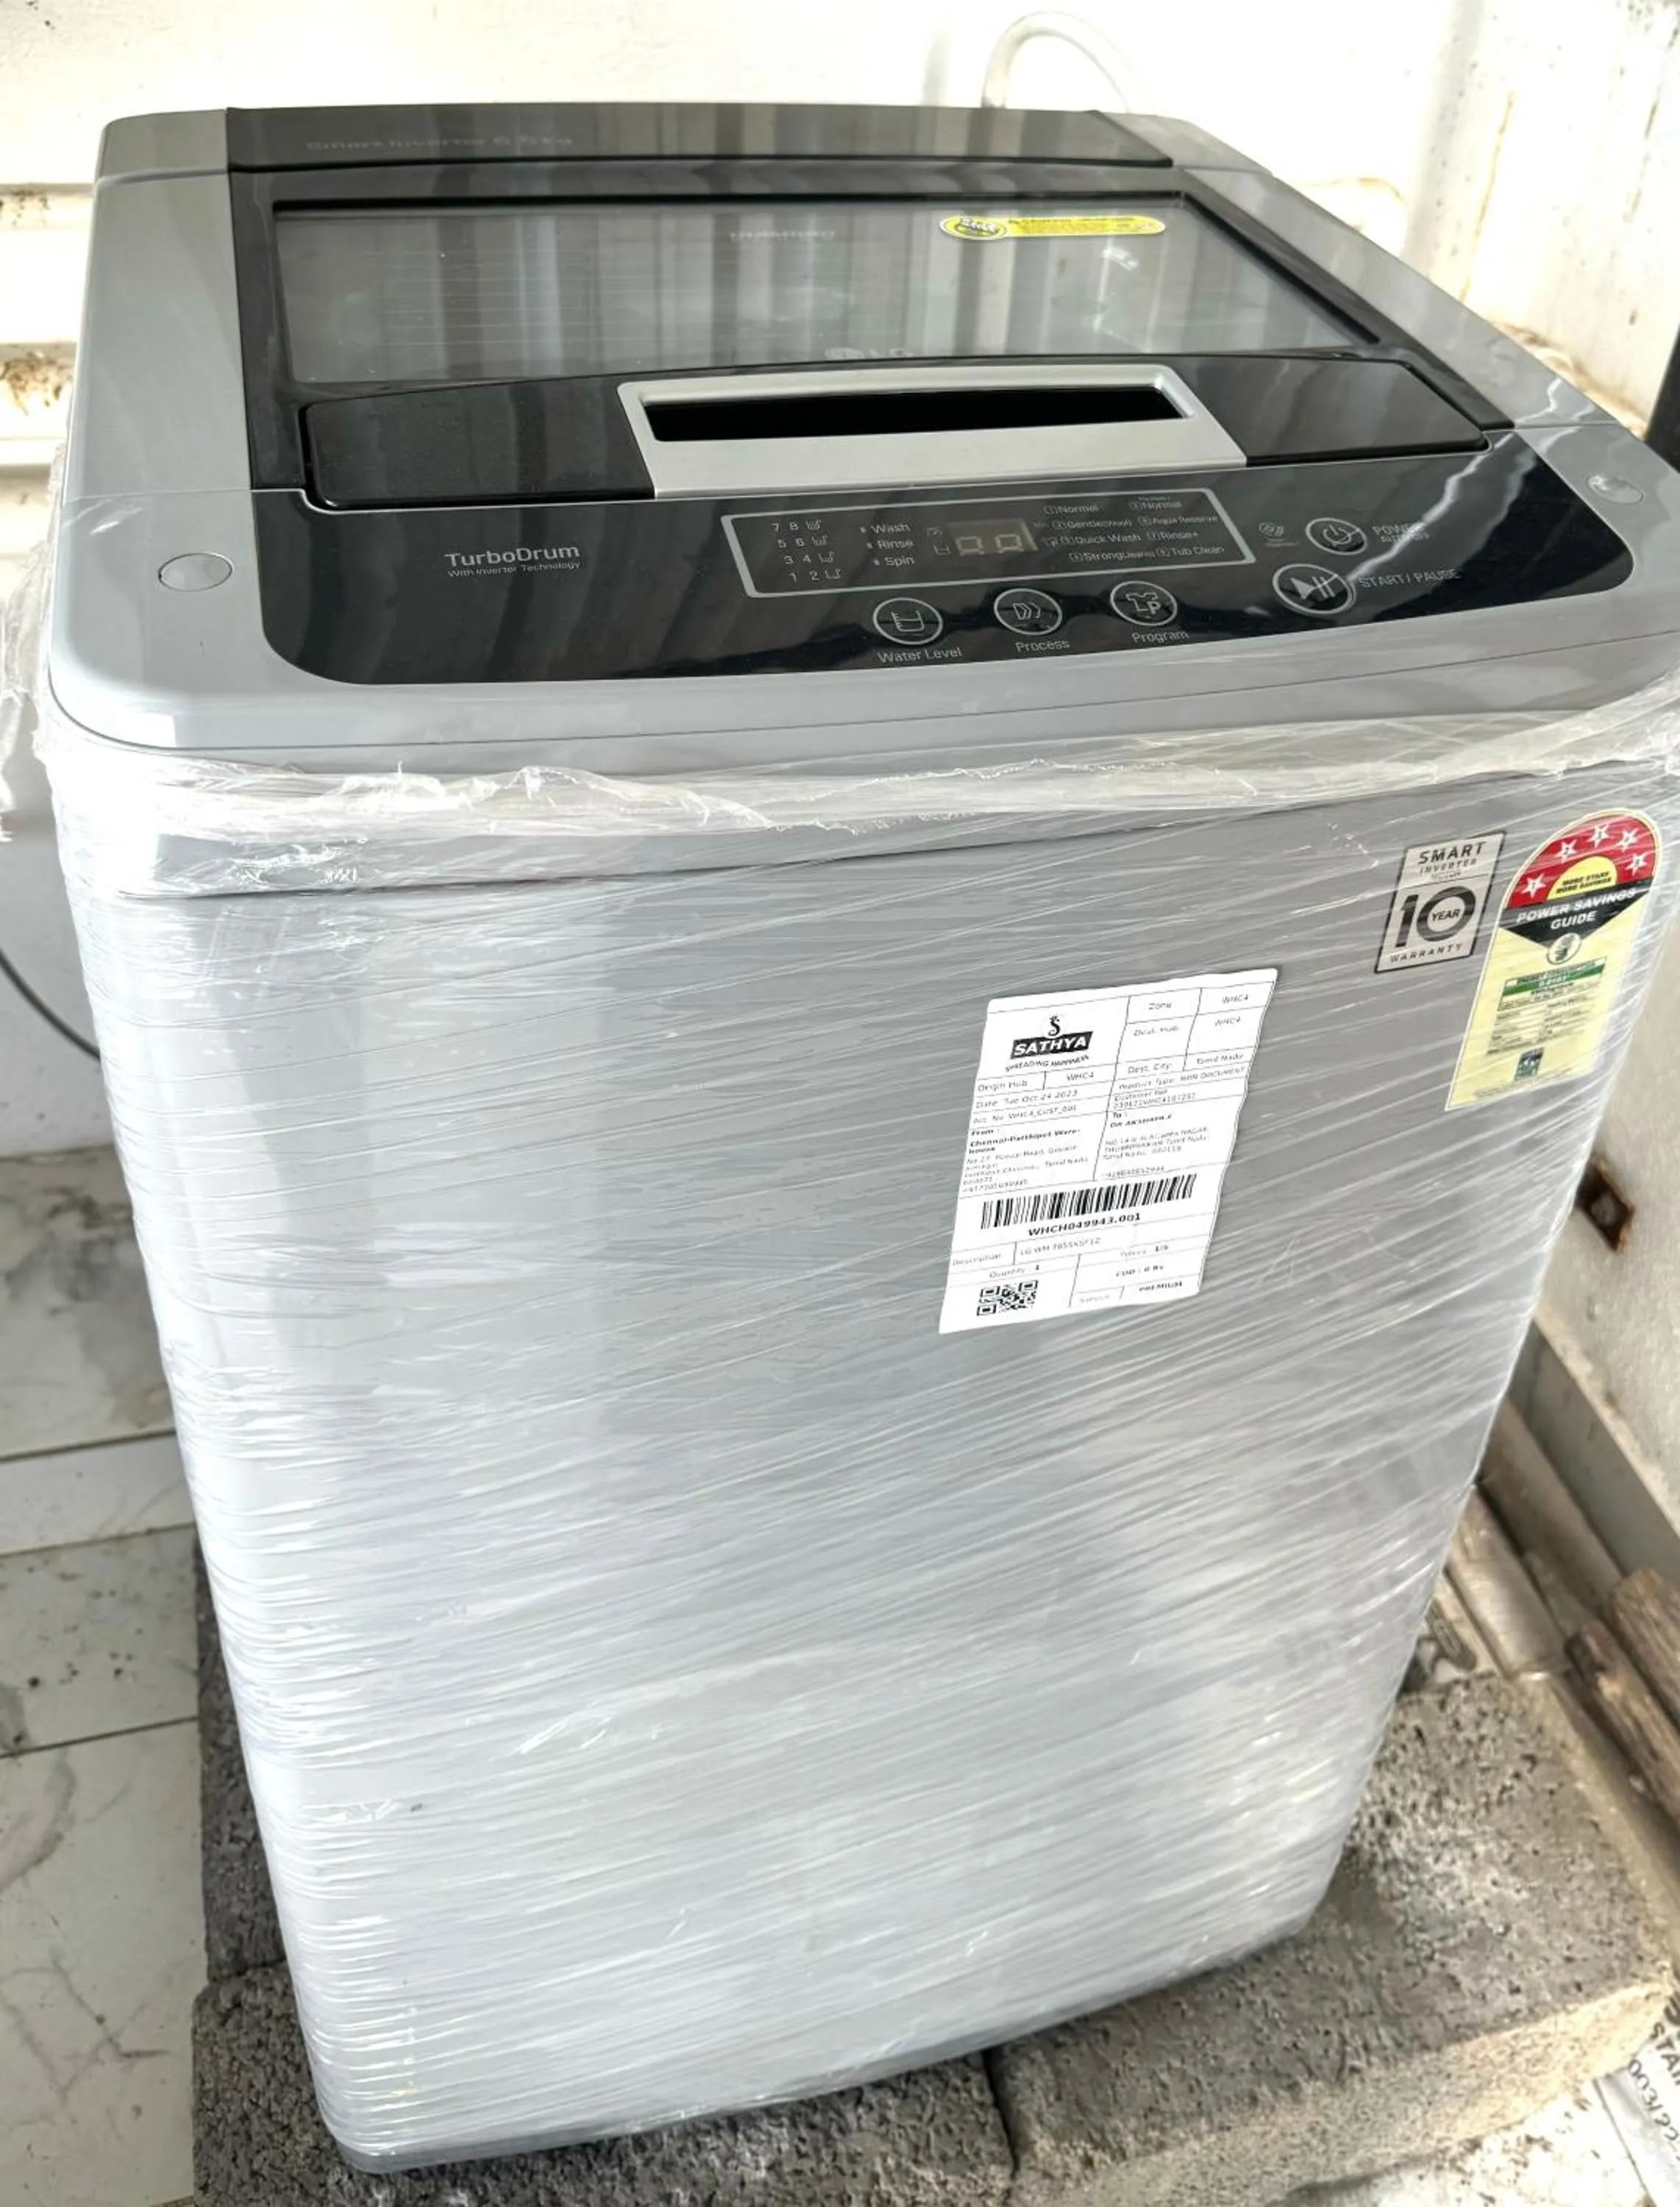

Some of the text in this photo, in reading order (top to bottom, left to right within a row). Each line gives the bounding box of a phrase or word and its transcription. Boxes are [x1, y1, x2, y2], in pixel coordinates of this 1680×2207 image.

[772, 522, 799, 532] 7 8
[871, 522, 911, 534] Wash
[777, 538, 806, 548] 5 6
[877, 539, 915, 550] Rinse
[444, 547, 581, 566] TurboDrum
[784, 554, 811, 565] 3 4
[884, 555, 915, 567] Spin
[520, 561, 581, 572] Technology
[789, 570, 820, 581] 1 2
[1359, 575, 1404, 589] START
[1414, 568, 1463, 583] PAUSE
[1132, 629, 1189, 644] Program
[1015, 639, 1070, 653] Process
[878, 646, 964, 663] Water Level
[1418, 841, 1488, 864] SMART
[1420, 859, 1477, 874] INVERTER
[1516, 887, 1637, 923] POWER SAVINGS
[1395, 885, 1476, 948] 10
[1431, 909, 1461, 921] YEAR
[1550, 909, 1598, 930] GUIDE
[1389, 942, 1463, 962] WARRANTY
[1014, 1036, 1087, 1056] SATHYA
